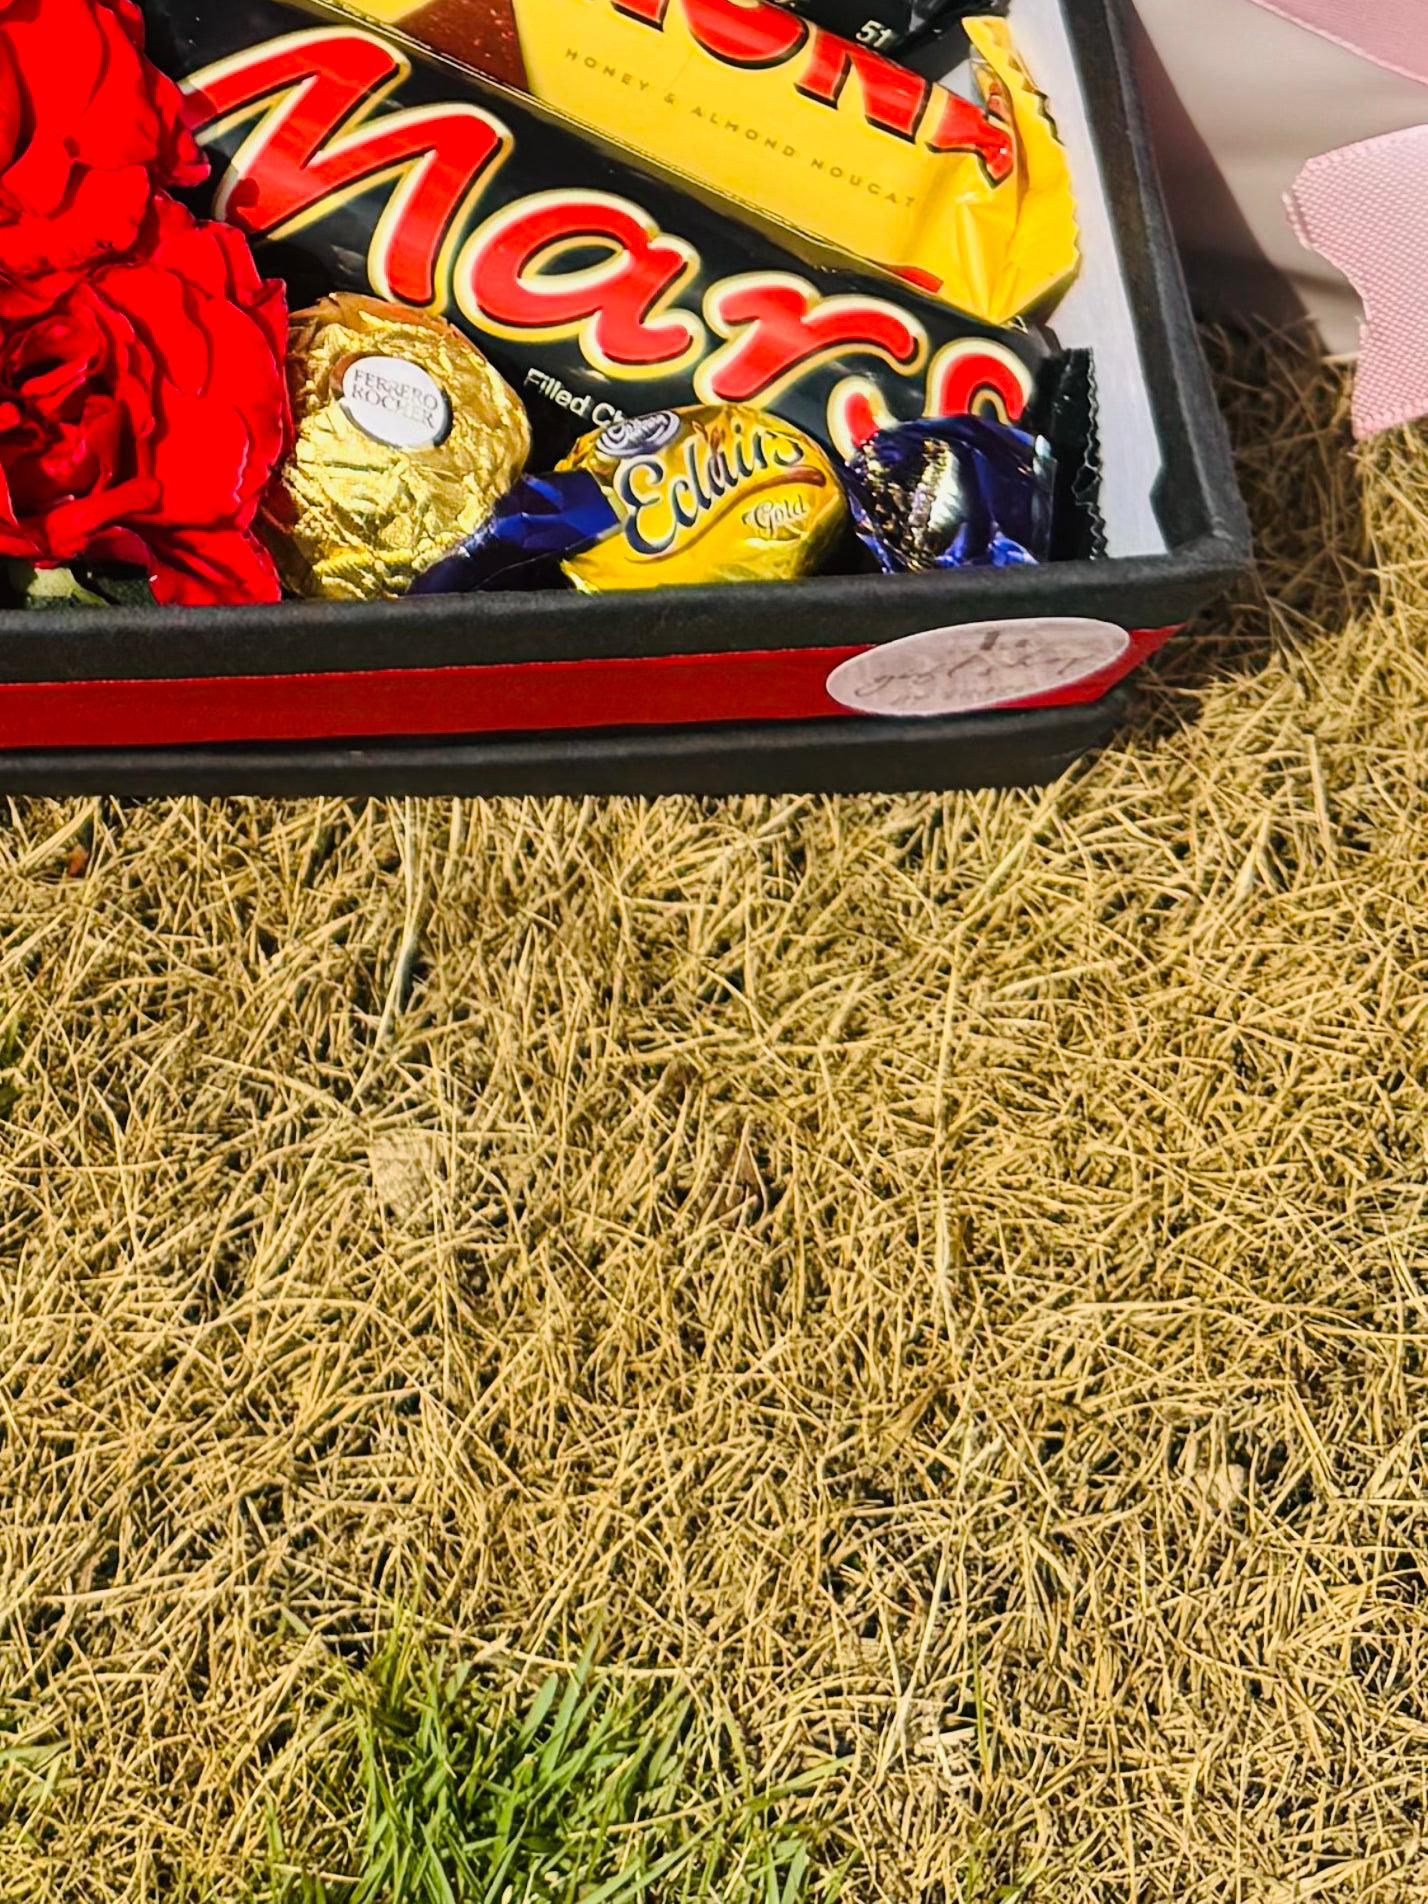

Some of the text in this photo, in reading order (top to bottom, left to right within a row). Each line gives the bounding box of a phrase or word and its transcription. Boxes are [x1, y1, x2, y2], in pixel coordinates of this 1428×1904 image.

[565, 47, 918, 209] HONEY & ALMOND NOUGAT
[351, 383, 436, 431] ROCHER
[352, 368, 439, 412] FERRERO
[524, 367, 593, 419] Filled
[614, 422, 805, 559] Eclairs
[742, 494, 809, 532] Gold
